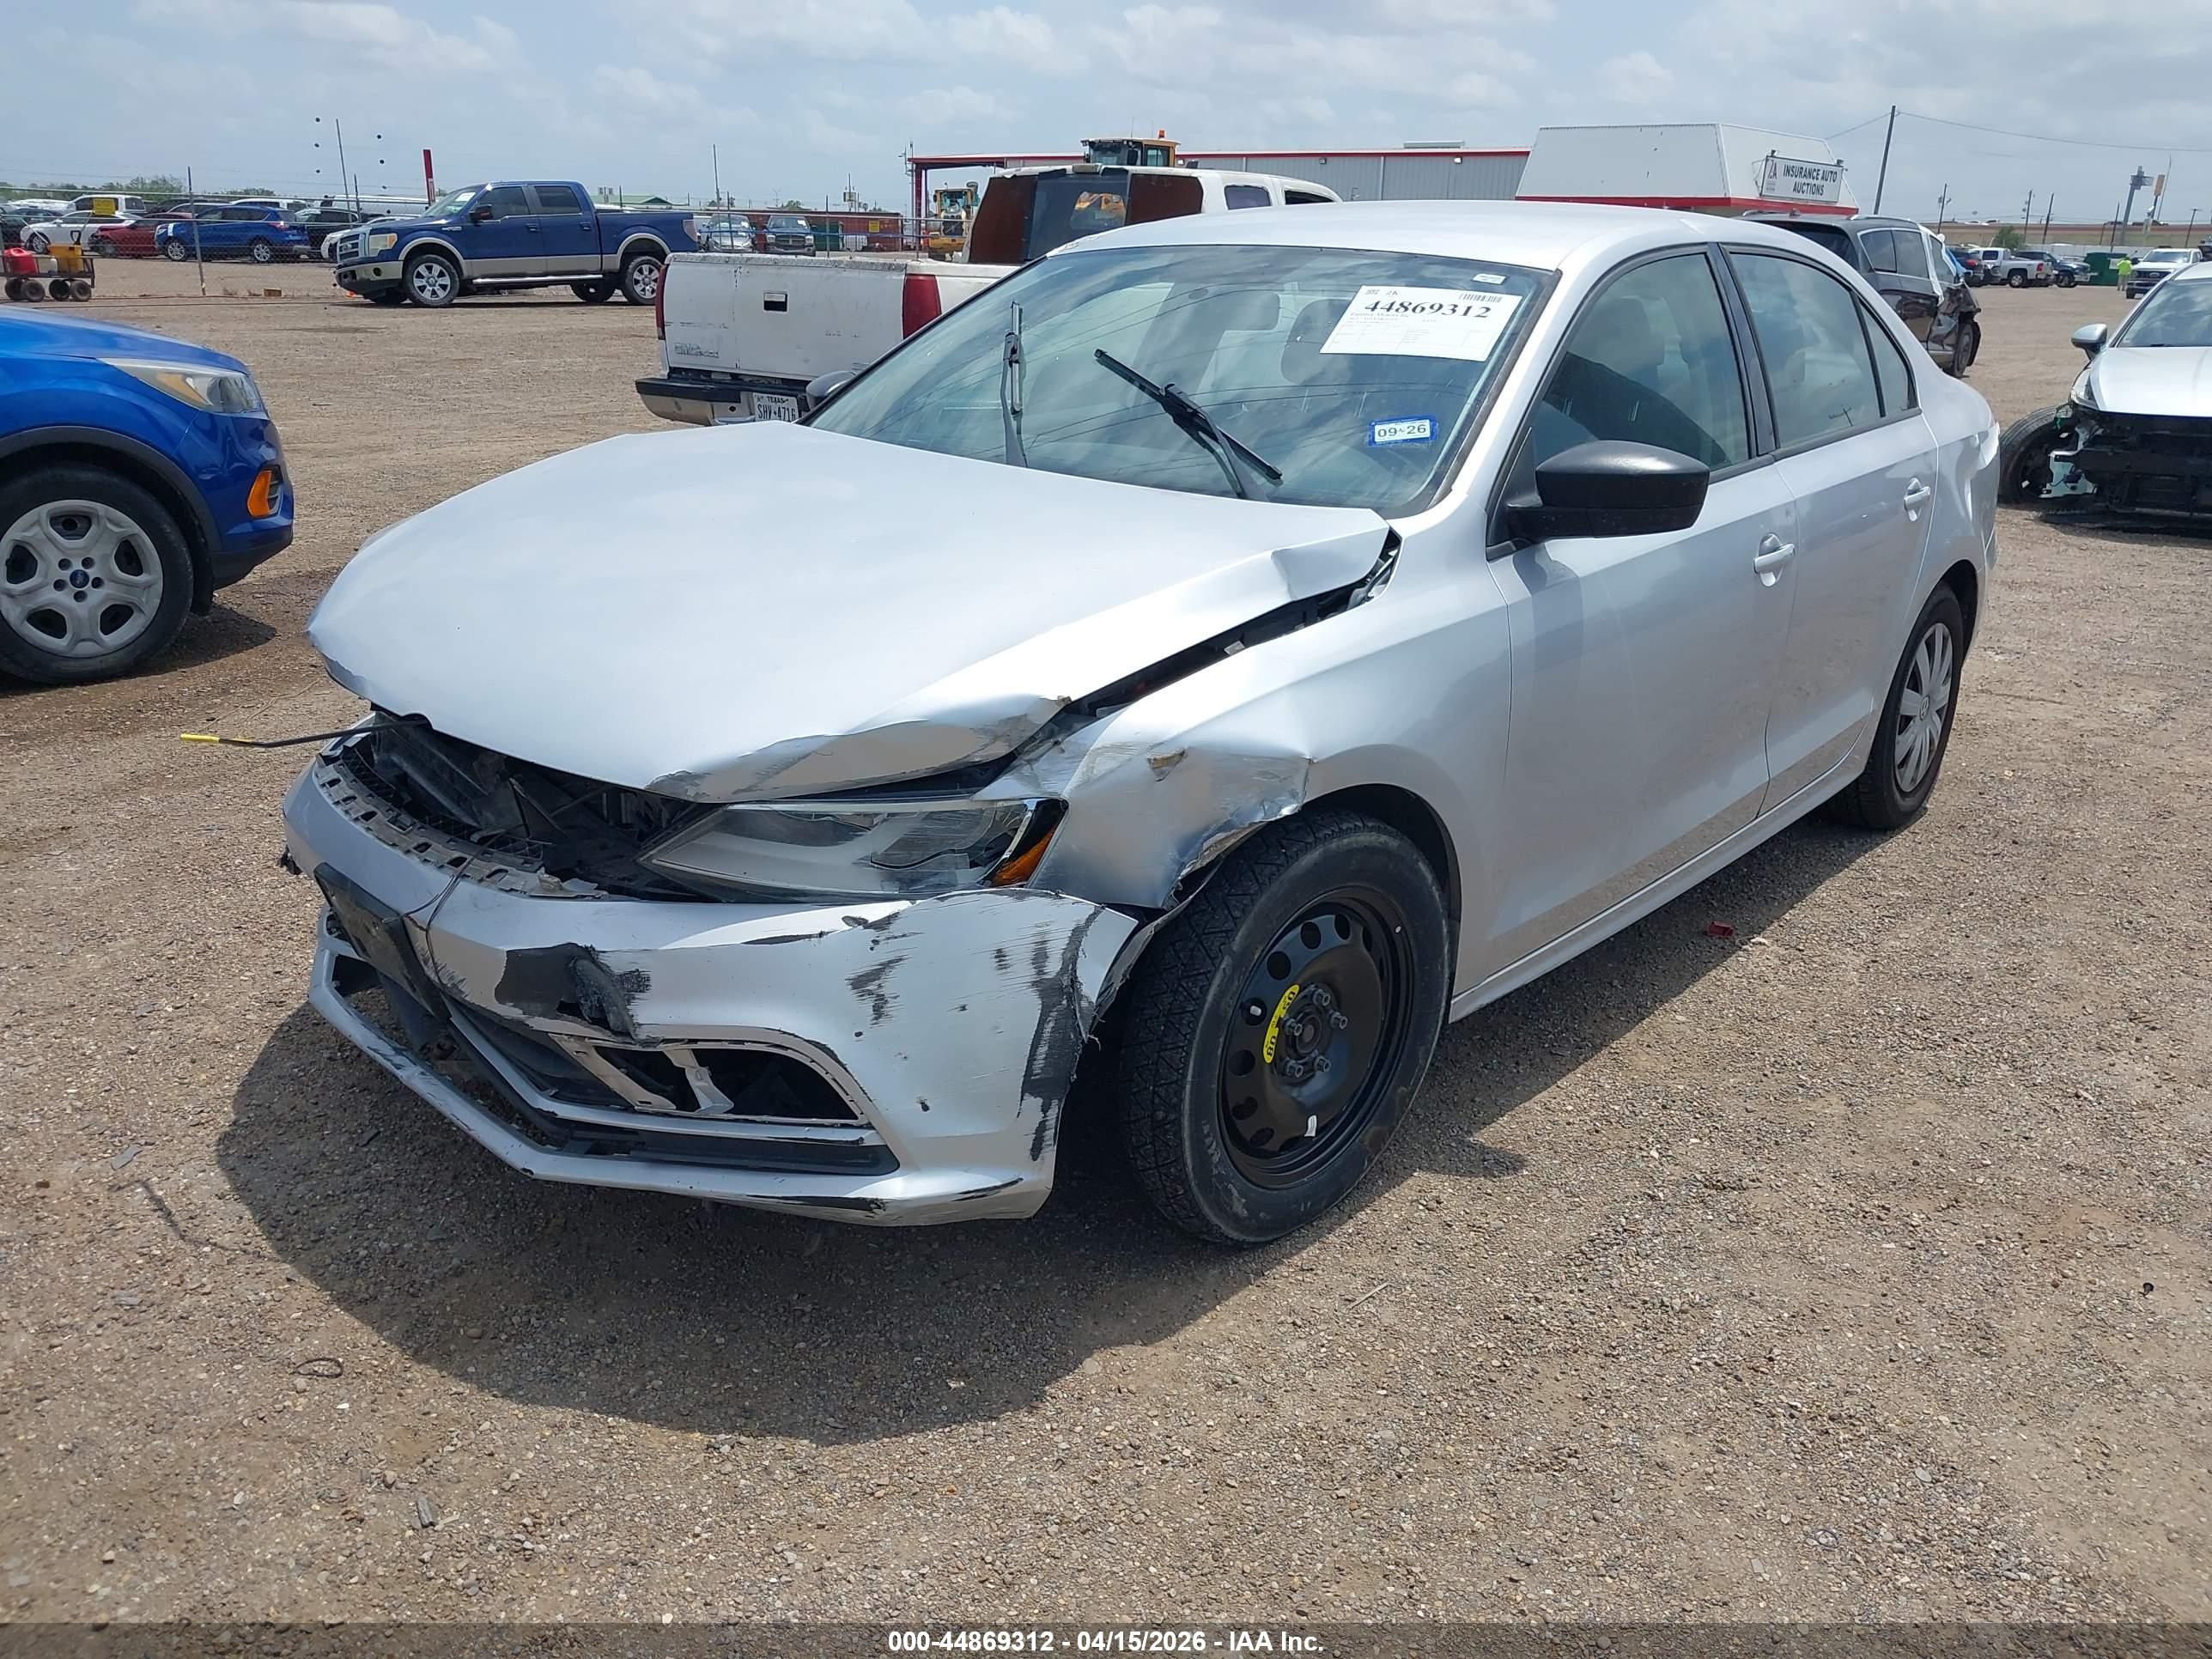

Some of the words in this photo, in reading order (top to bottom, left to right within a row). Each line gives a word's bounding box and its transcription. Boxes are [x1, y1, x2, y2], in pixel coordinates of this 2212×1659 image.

[1783, 164, 1820, 181] INSURANCE
[1821, 169, 1838, 183] AUTO
[1792, 180, 1825, 197] AUCTIONS
[1364, 300, 1492, 319] 44869312
[766, 395, 785, 404] TEXAS
